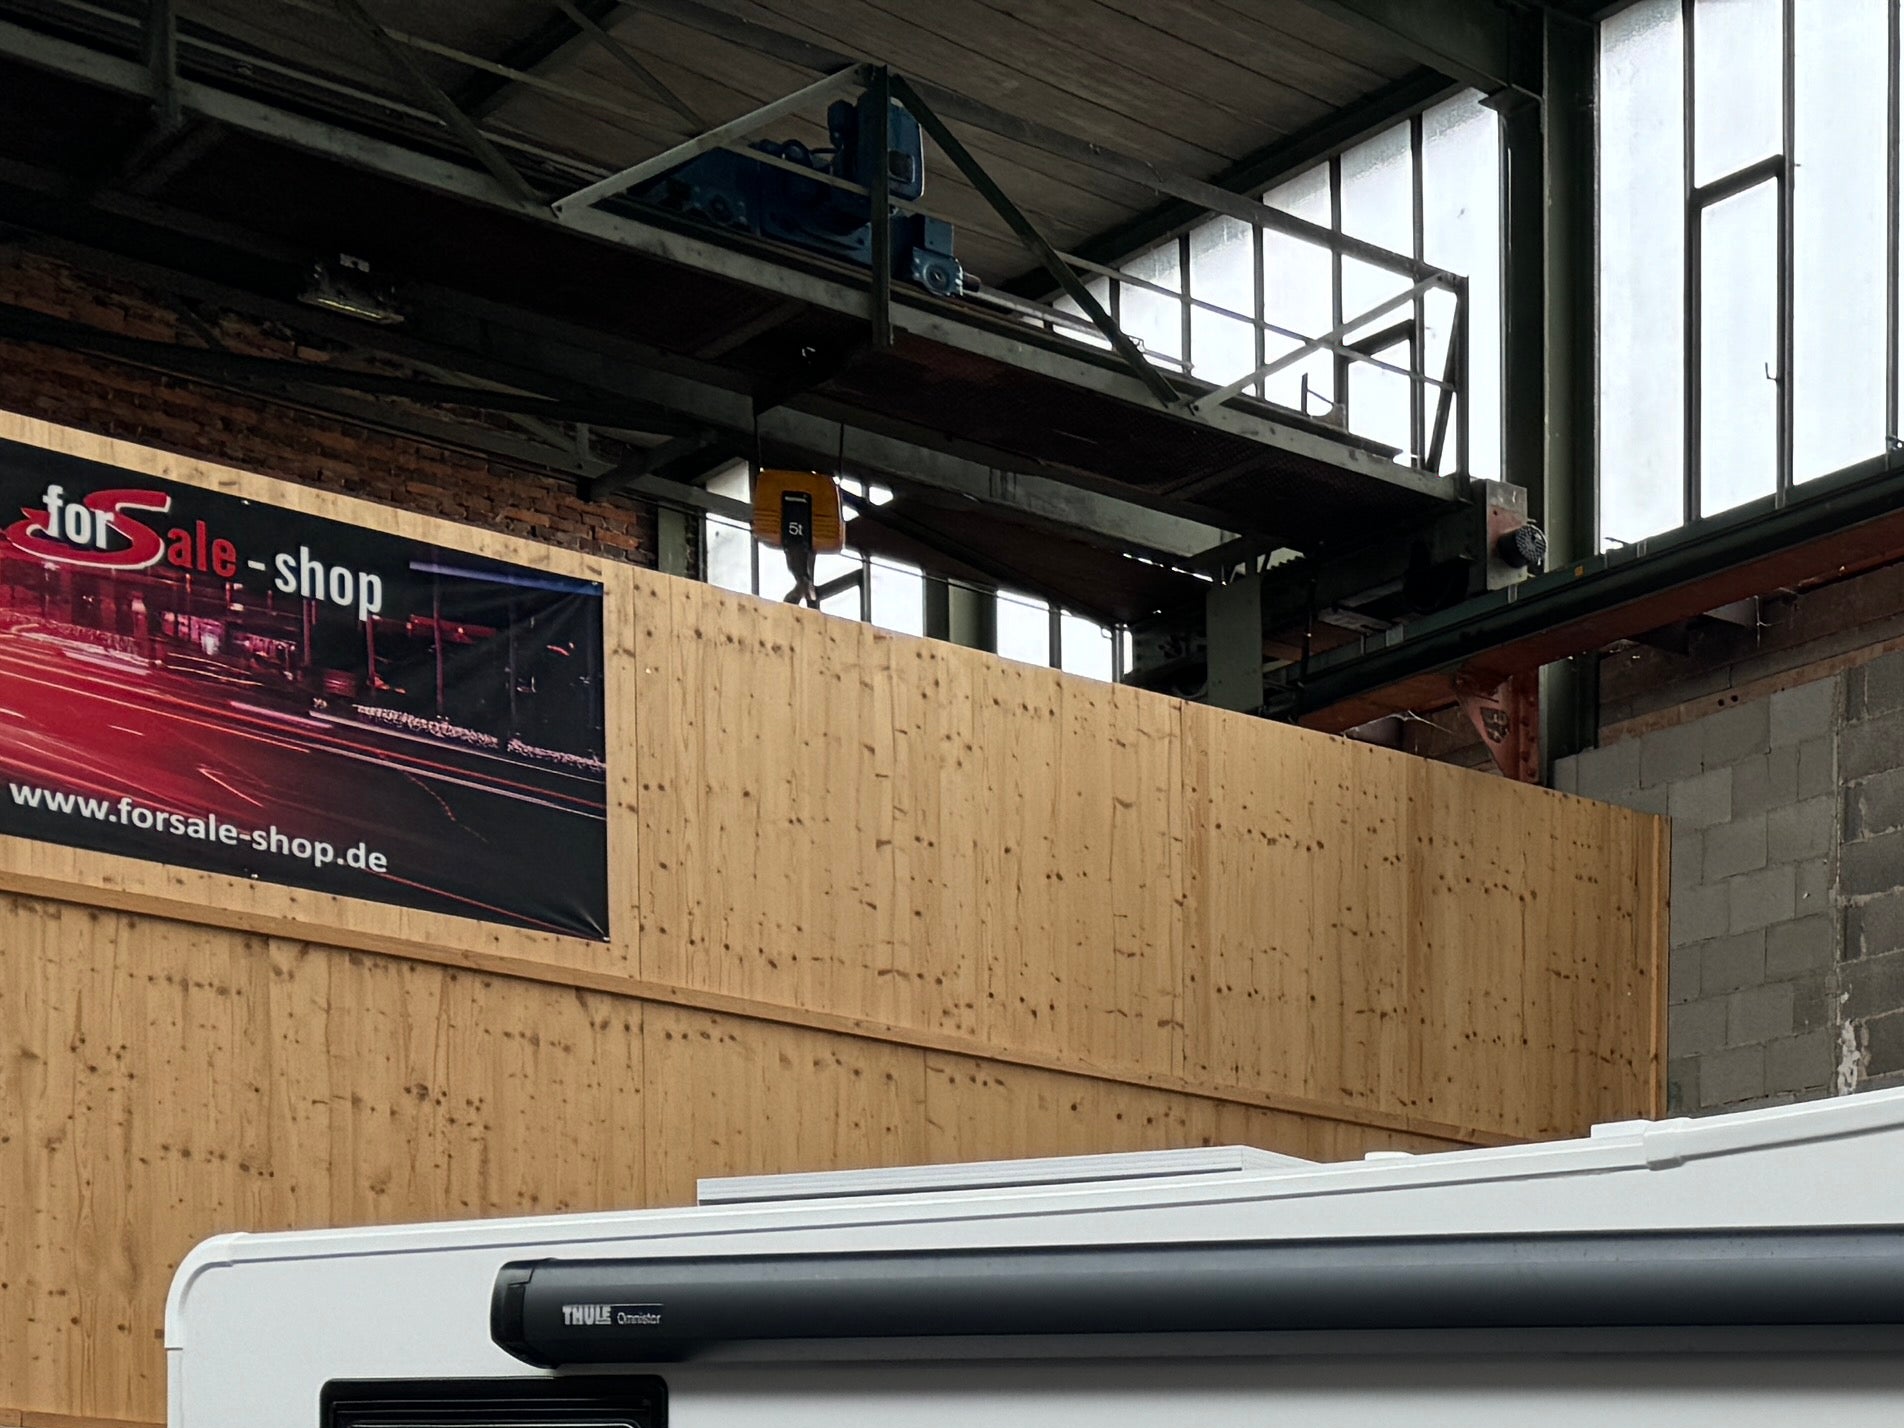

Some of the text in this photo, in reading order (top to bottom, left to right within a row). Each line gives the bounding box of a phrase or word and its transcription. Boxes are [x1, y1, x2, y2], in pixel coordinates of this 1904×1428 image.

[788, 521, 803, 536] 5t
[9, 783, 388, 873] www.forsale-shop.de
[562, 1304, 612, 1326] THULE
